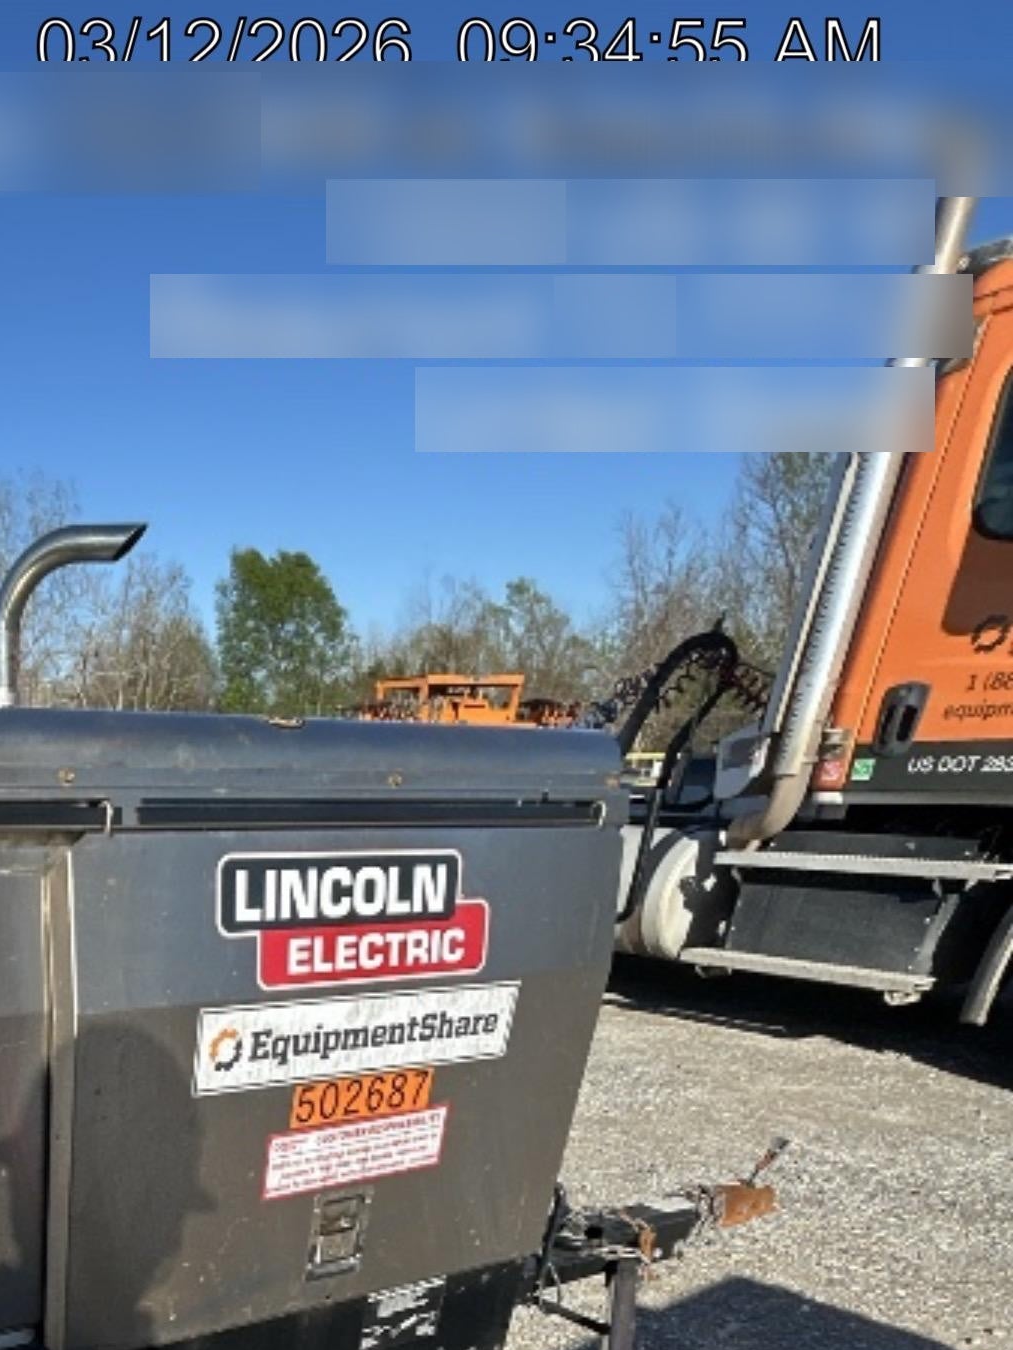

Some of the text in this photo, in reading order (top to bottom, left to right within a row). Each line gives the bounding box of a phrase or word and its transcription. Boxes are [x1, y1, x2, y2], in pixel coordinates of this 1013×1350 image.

[943, 699, 1013, 722] equipm
[907, 755, 935, 773] US
[937, 755, 981, 772] DOT
[234, 864, 448, 922] LINCOLN
[287, 928, 466, 976] ELECTRIC
[247, 1010, 500, 1065] EquipmentShare
[295, 1071, 429, 1124] 502687
